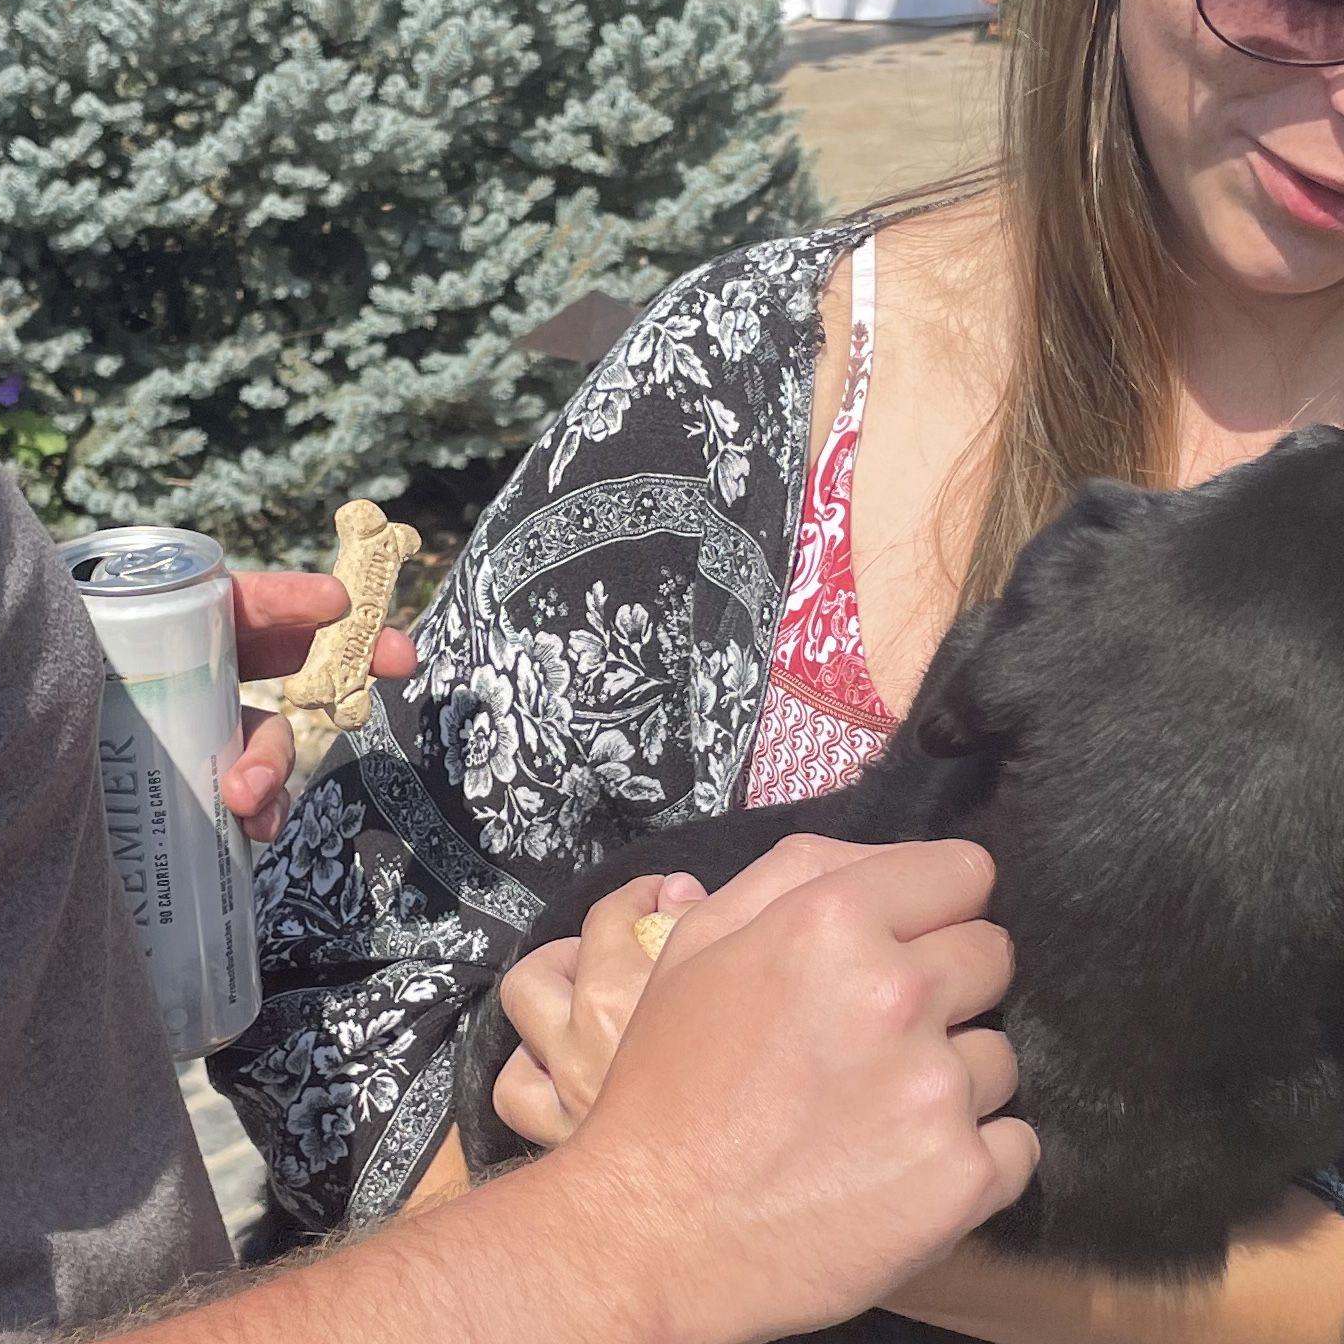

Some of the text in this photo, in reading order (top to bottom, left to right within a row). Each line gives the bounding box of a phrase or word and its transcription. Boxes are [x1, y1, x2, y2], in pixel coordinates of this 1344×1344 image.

[99, 735, 153, 957] EMIER
[147, 769, 173, 925] 90 CALORIES 2.6g CARBS
